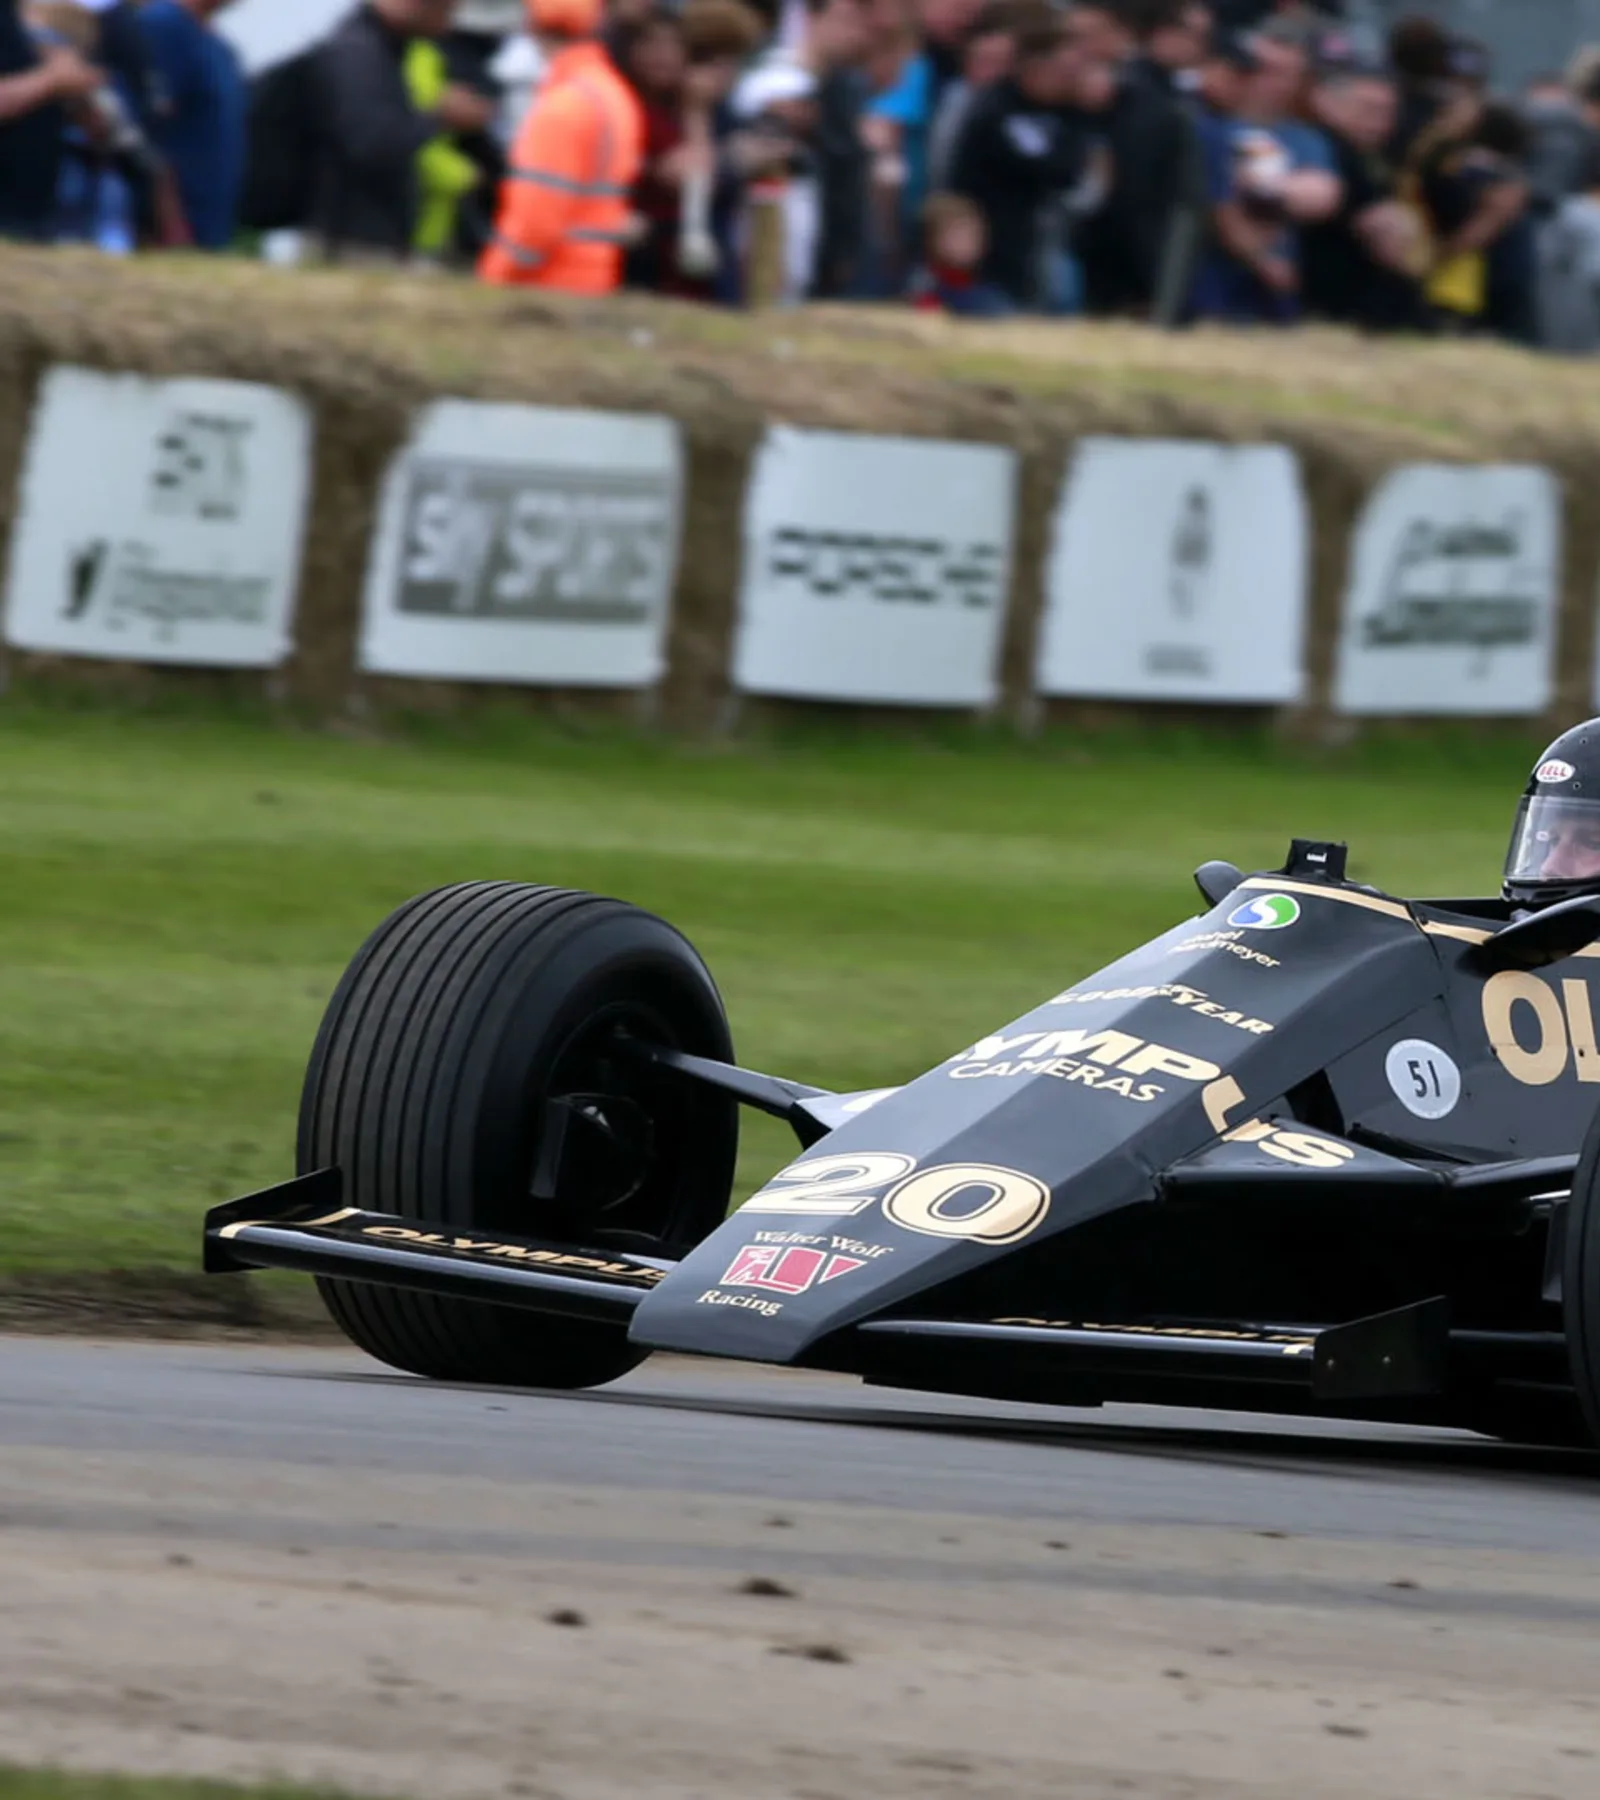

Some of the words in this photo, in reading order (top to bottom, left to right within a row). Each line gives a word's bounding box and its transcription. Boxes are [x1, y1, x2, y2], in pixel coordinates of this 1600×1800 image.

[948, 1057, 1166, 1102] CAMERAS
[1408, 1059, 1442, 1099] 51
[737, 1151, 1051, 1246] 20
[754, 1230, 828, 1244] Walter
[830, 1235, 895, 1259] Wolf
[696, 1289, 784, 1317] Racing
